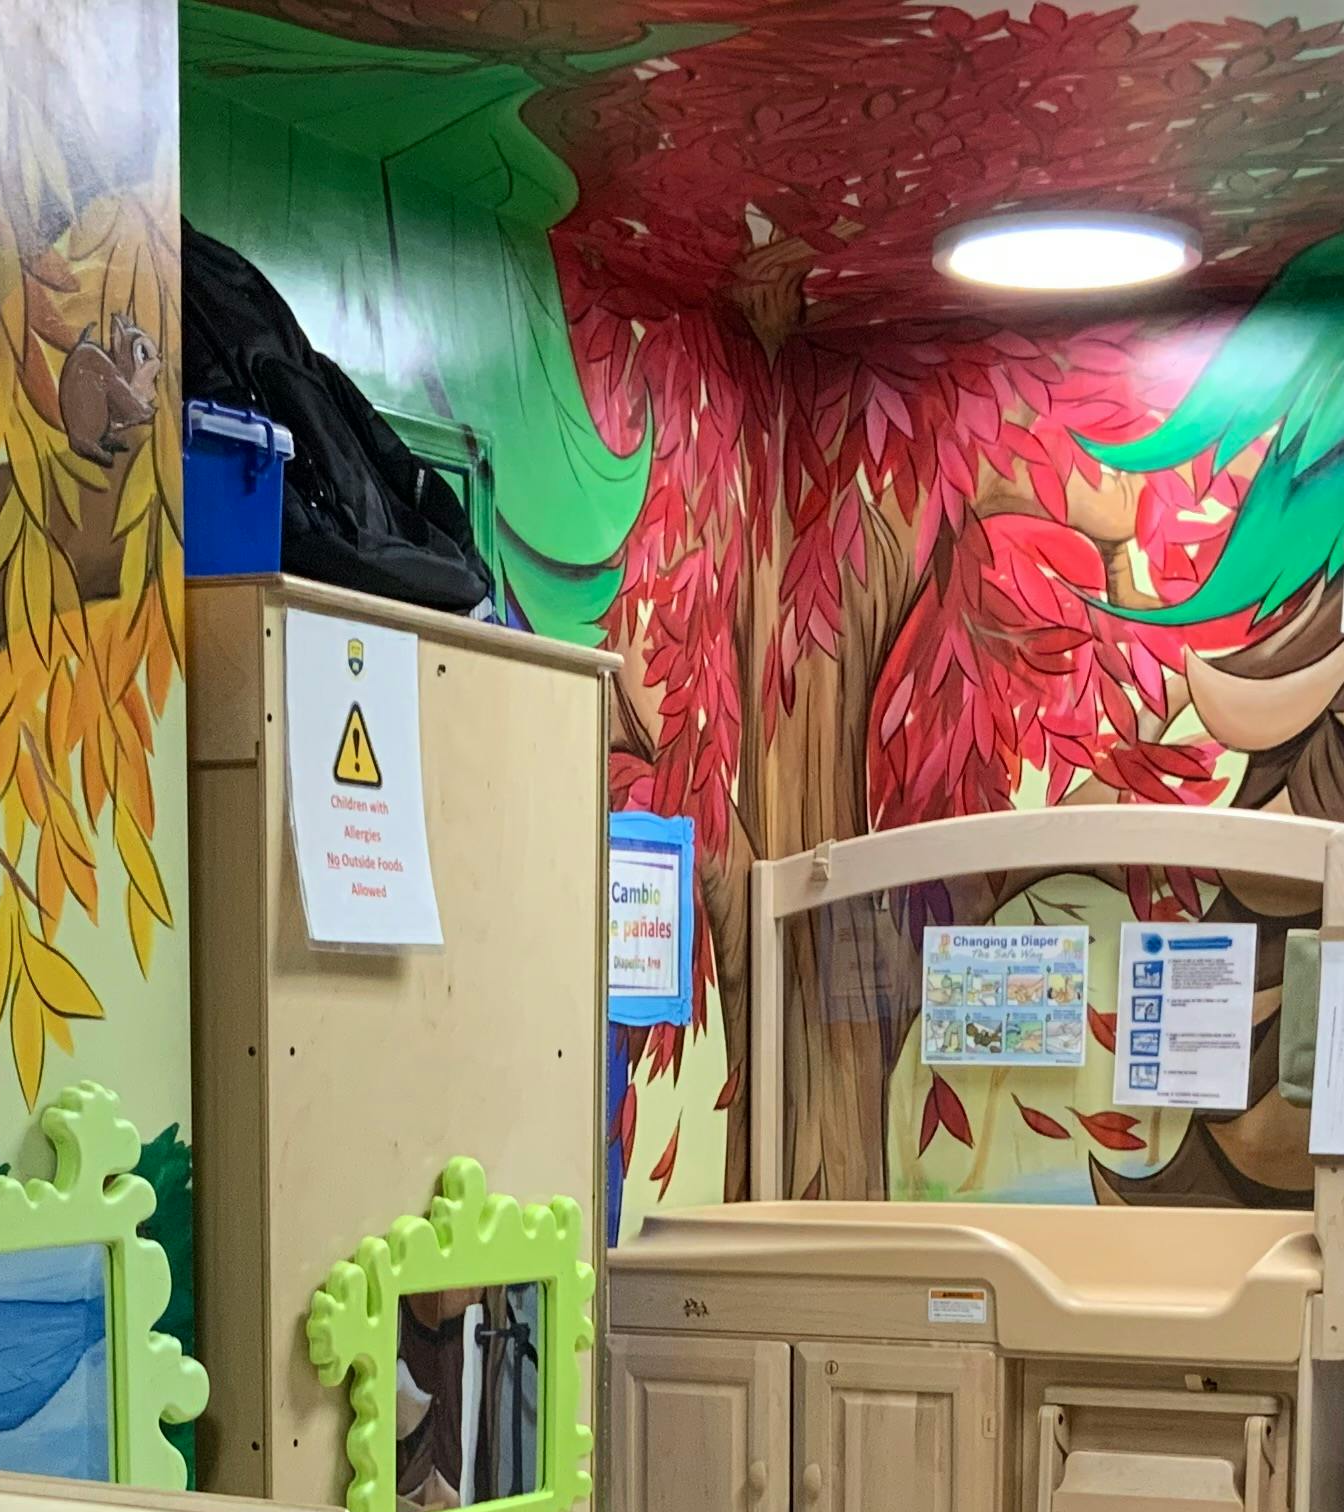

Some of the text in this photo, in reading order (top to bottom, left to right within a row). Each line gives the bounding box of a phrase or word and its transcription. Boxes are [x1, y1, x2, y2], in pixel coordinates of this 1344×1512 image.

[330, 794, 389, 815] Children with
[344, 825, 381, 844] Allergies
[327, 852, 404, 873] No Outside Foods
[351, 882, 387, 899] Allowed
[611, 881, 661, 906] Cambio
[609, 915, 672, 943] e pañales
[953, 935, 1059, 949] Changing a Diaper
